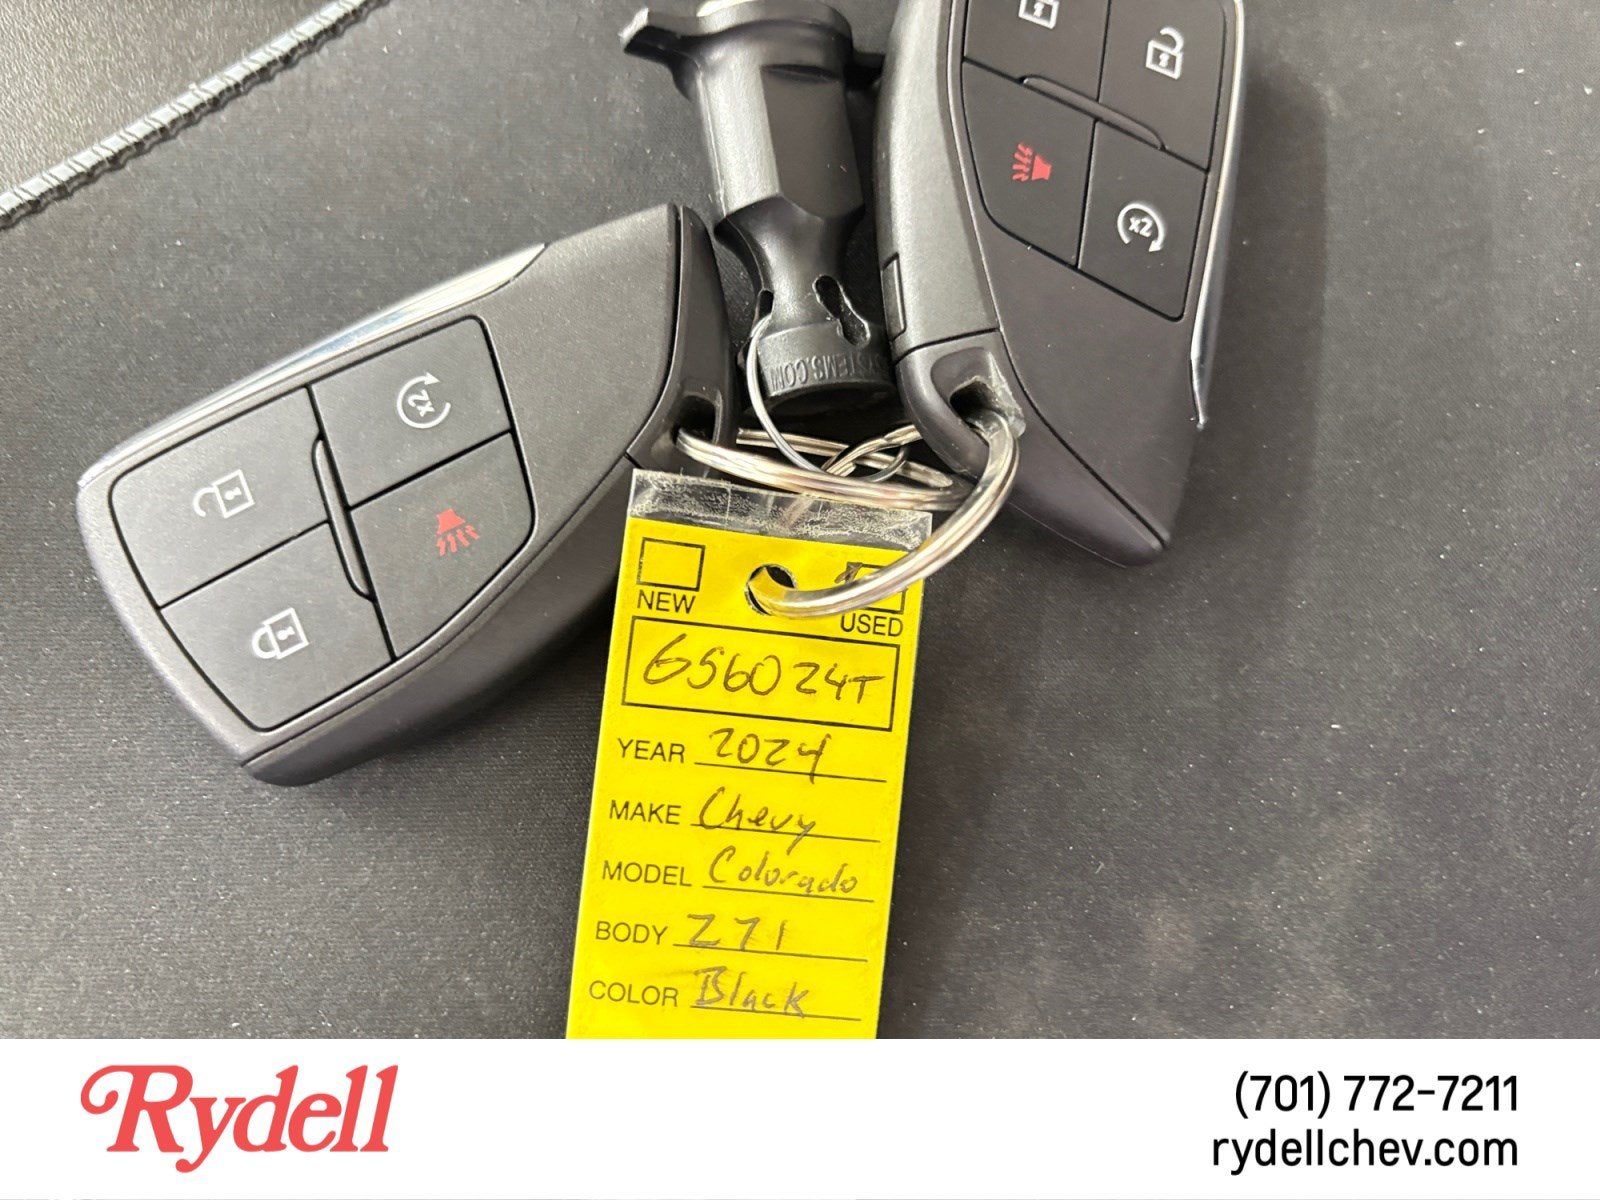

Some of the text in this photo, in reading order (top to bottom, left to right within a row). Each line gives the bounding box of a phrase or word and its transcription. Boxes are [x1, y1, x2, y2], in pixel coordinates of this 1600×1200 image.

[636, 589, 696, 614] NEW
[839, 613, 904, 638] USED
[616, 727, 832, 784] YEAR 2024
[608, 786, 818, 856] MAKE Chevy
[601, 844, 859, 897] MODEL Colorado
[594, 920, 669, 946] BODY
[588, 965, 811, 1019] COLOR Black
